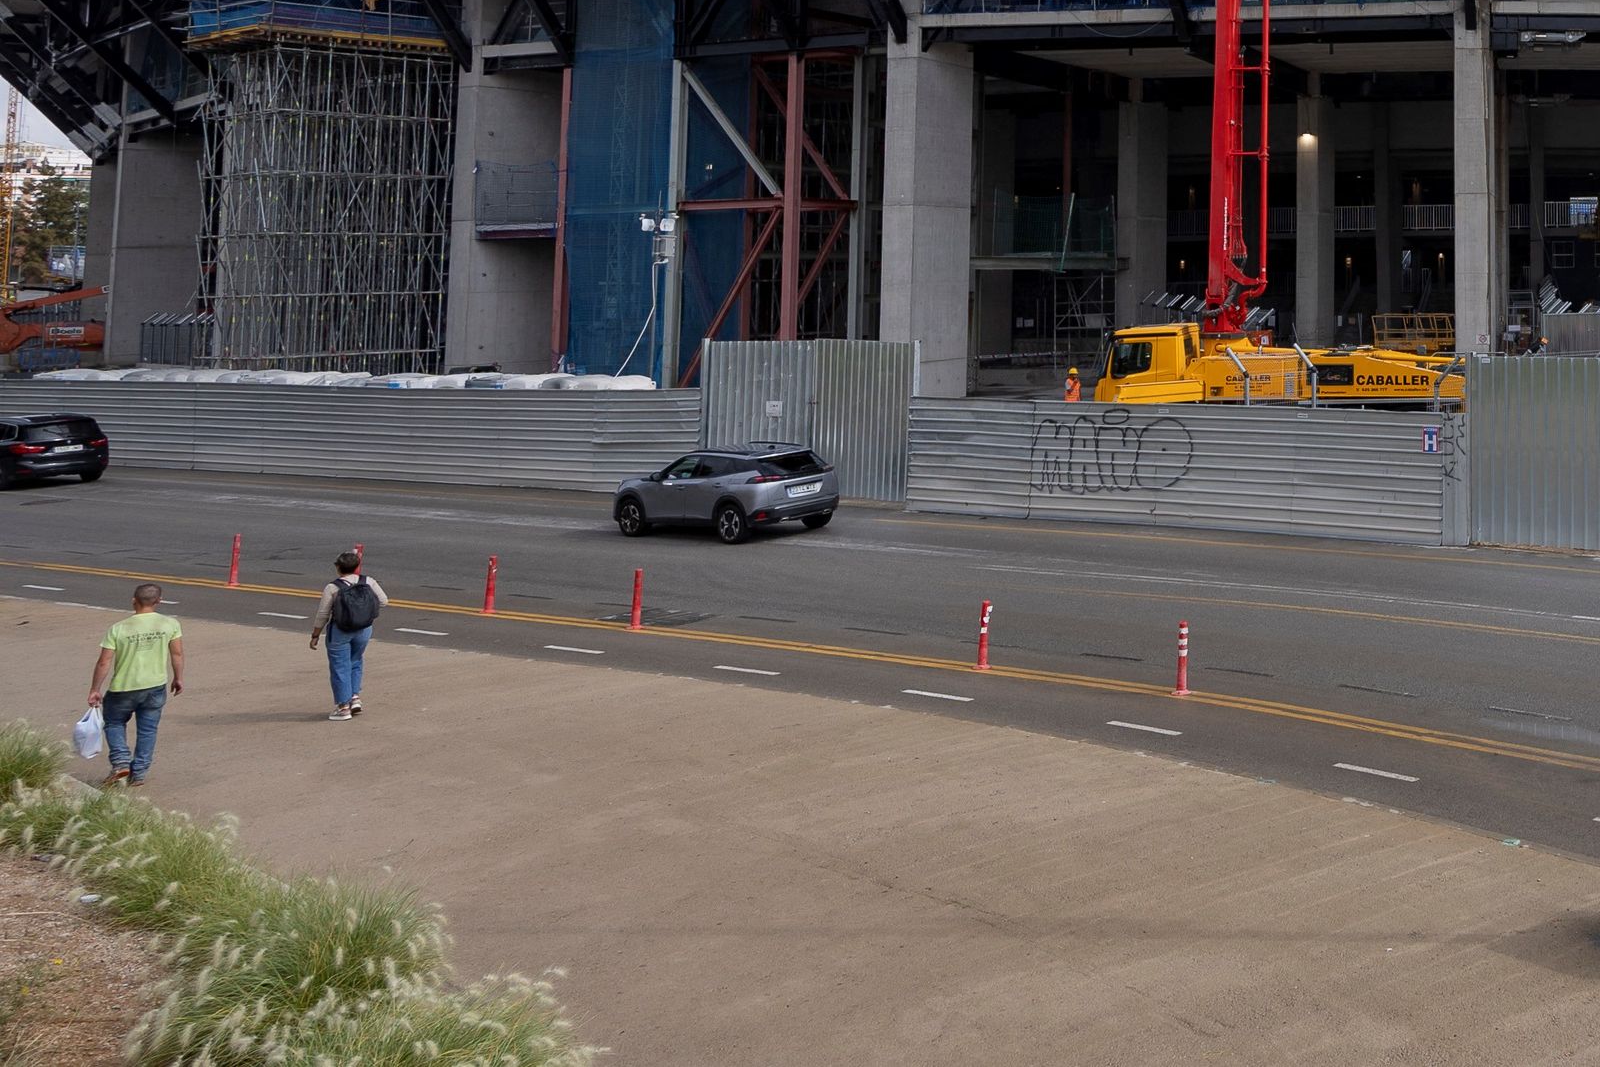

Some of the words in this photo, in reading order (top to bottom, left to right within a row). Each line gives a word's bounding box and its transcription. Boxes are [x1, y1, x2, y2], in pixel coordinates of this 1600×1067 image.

[1225, 374, 1271, 382] CABLLER
[1356, 375, 1429, 386] CABALLER
[1424, 434, 1437, 451] H
